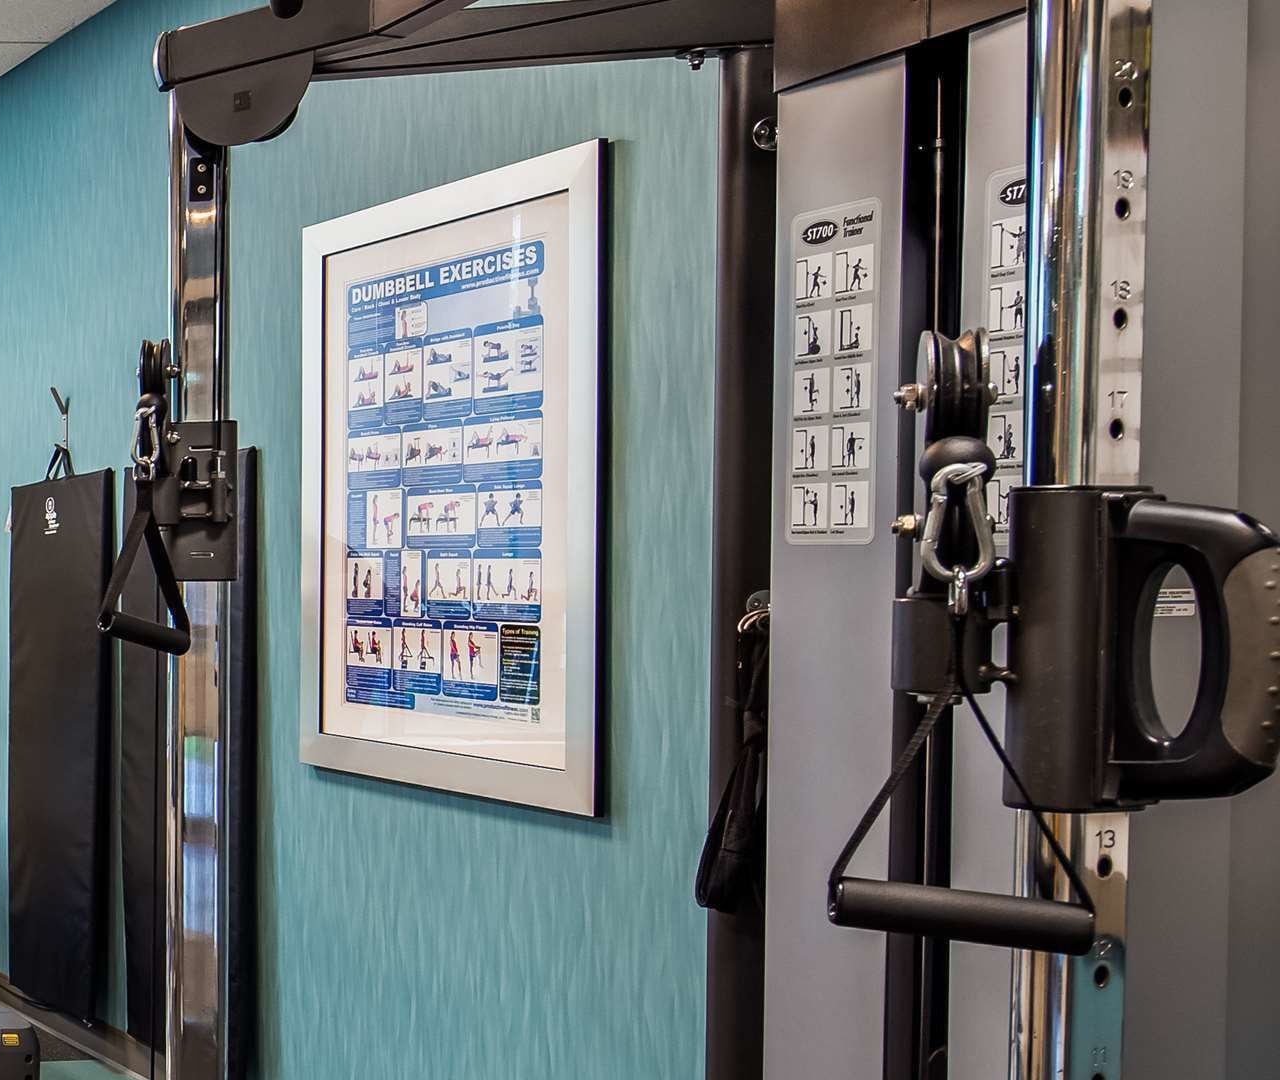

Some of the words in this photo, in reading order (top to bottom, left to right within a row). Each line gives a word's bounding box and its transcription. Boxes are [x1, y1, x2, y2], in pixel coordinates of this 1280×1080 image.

[1113, 169, 1134, 190] 19
[1005, 184, 1026, 201] ST7
[842, 210, 874, 228] Functional
[806, 223, 834, 241] ST700
[843, 227, 864, 238] Trainer
[351, 271, 434, 305] DUMBBELL
[439, 245, 537, 285] EXERCISES
[1110, 279, 1132, 300] 18
[1107, 390, 1129, 410] 17
[1095, 829, 1116, 850] 13
